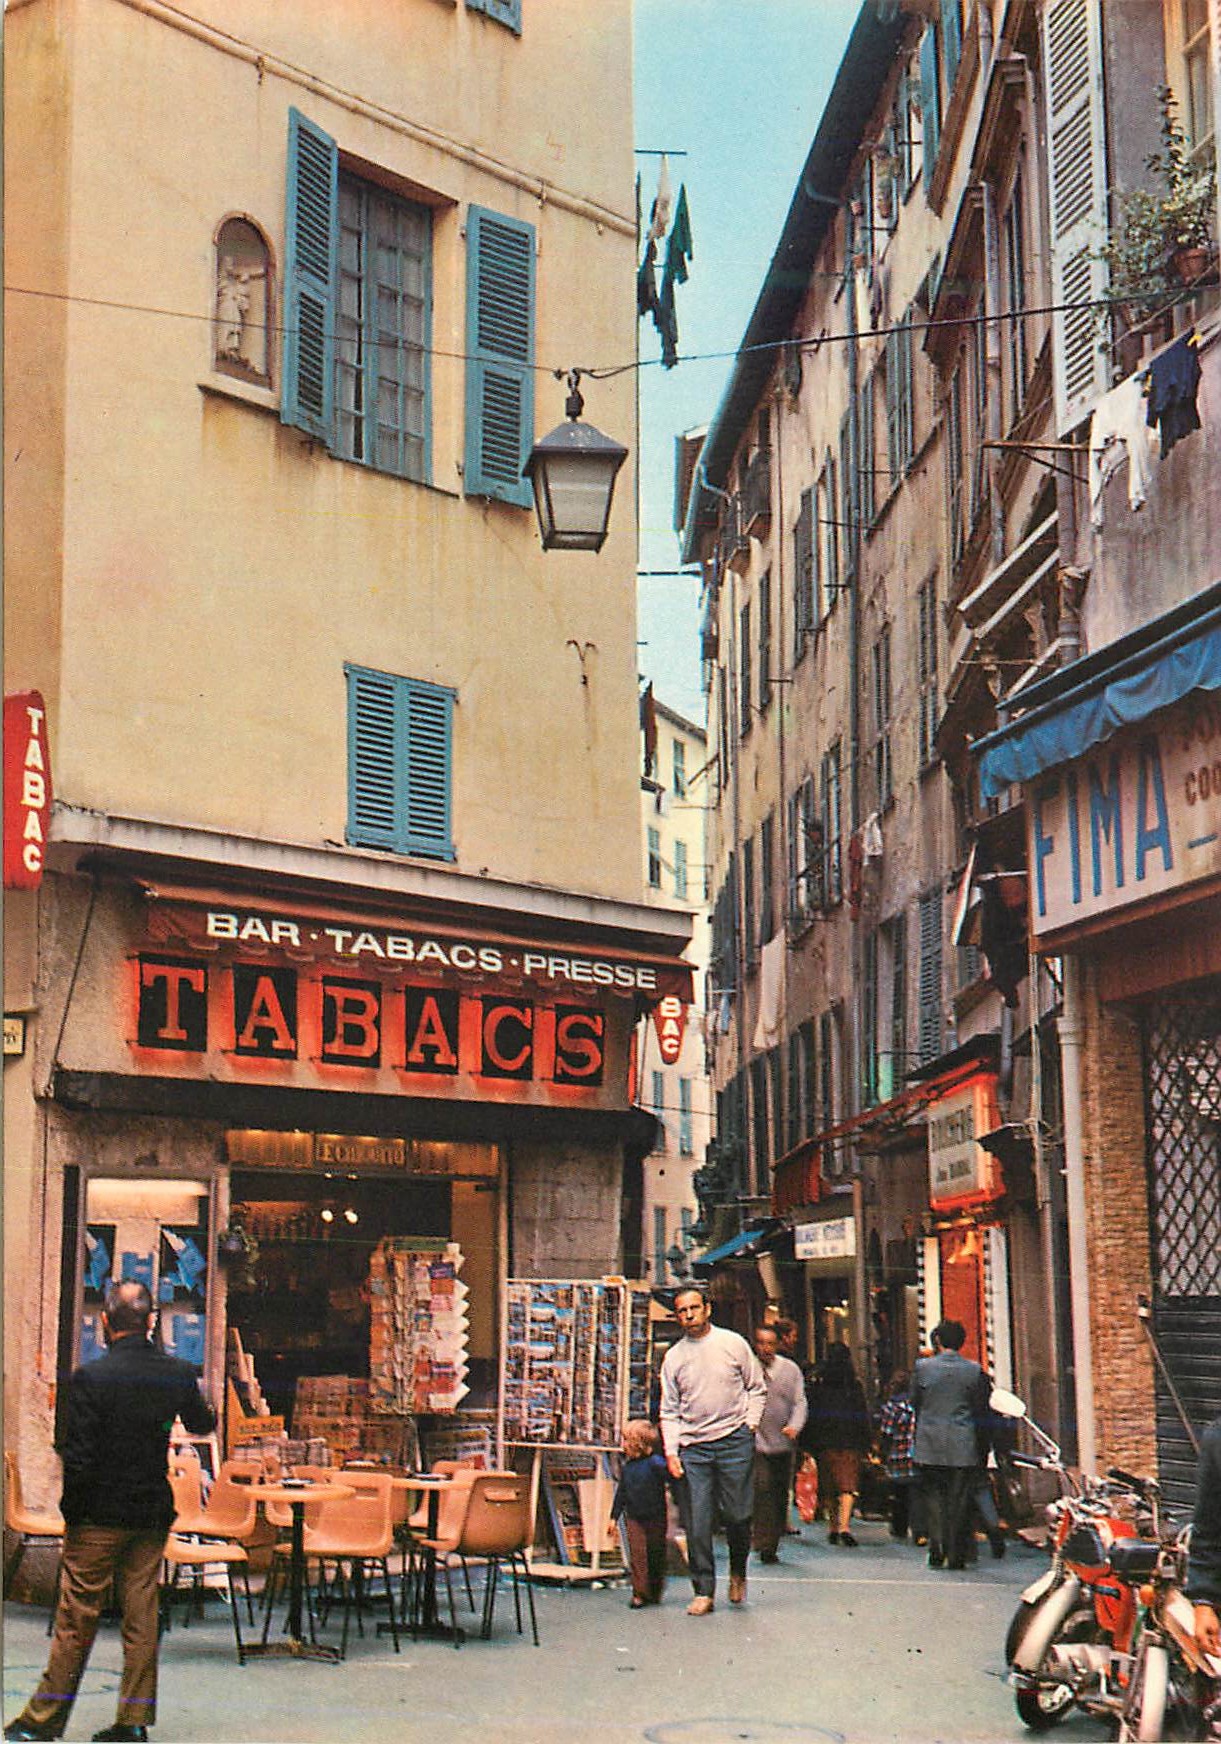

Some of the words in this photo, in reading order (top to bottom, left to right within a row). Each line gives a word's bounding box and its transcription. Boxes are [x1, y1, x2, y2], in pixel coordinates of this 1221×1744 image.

[20, 706, 46, 872] TABAC
[1033, 732, 1173, 917] FIMA
[141, 961, 603, 1077] TABACS
[207, 912, 301, 946] BAR
[325, 927, 503, 972] TABACS
[523, 952, 657, 990] PRESSE
